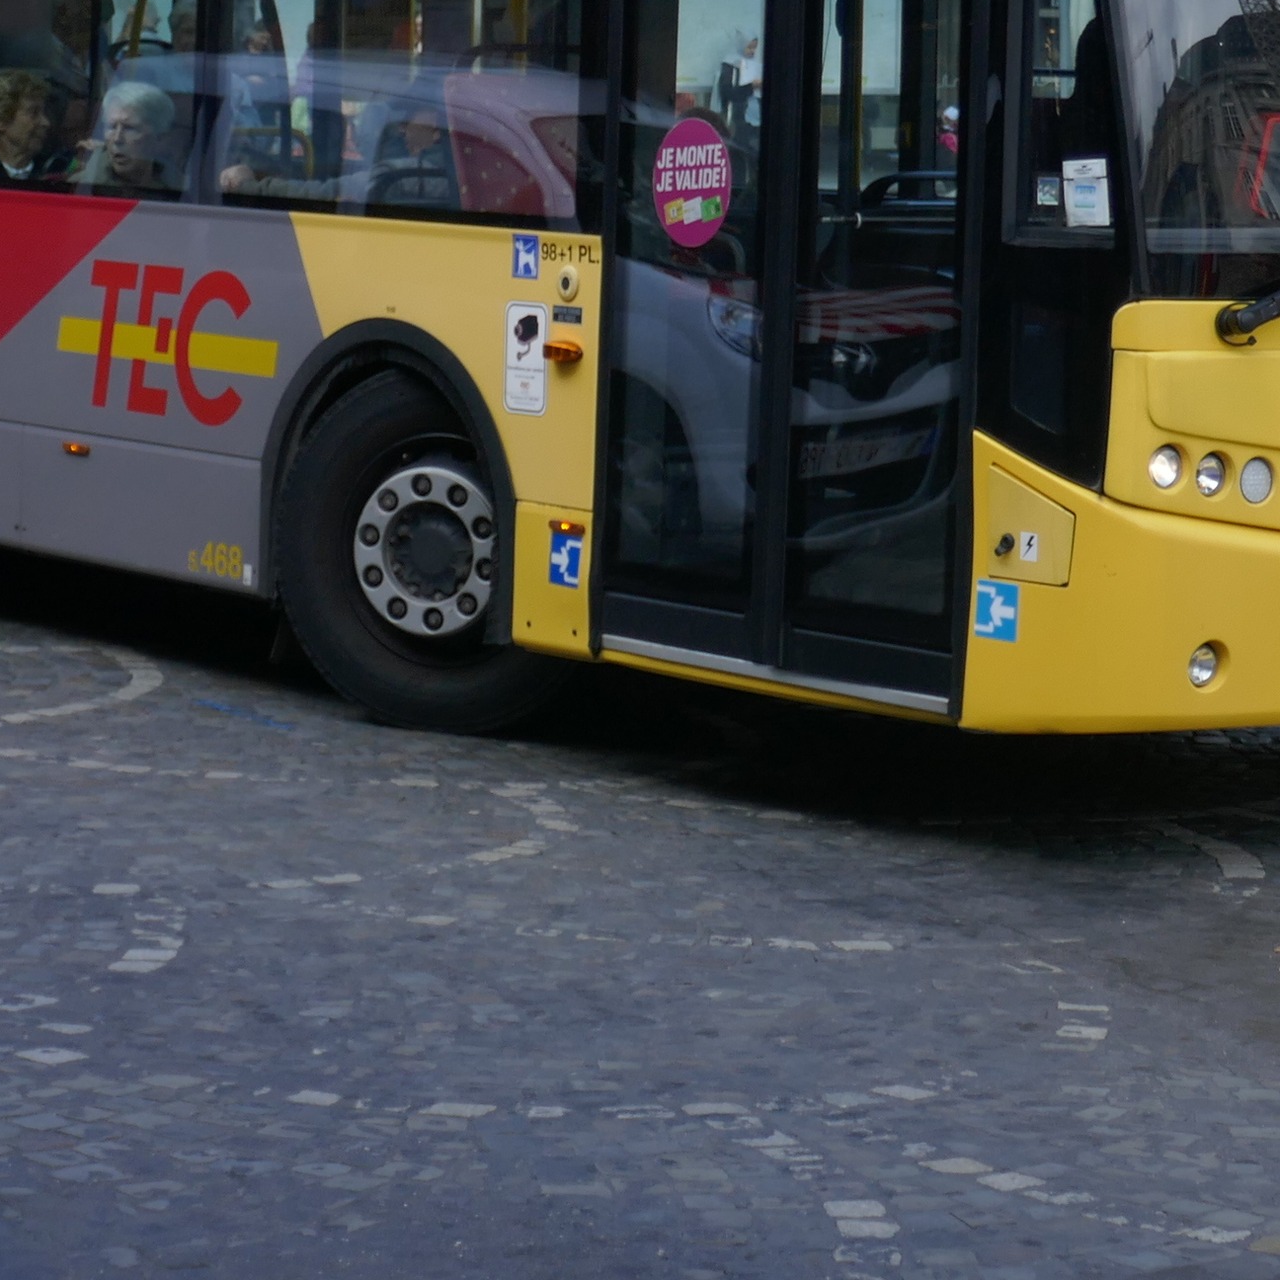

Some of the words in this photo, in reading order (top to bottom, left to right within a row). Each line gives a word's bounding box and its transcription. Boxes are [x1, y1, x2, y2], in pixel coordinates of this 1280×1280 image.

[657, 147, 674, 170] JE
[675, 143, 726, 168] MONTE,
[656, 170, 674, 193] JE
[541, 243, 573, 262] 98+1
[578, 245, 600, 264] PL.
[91, 259, 252, 427] TEC
